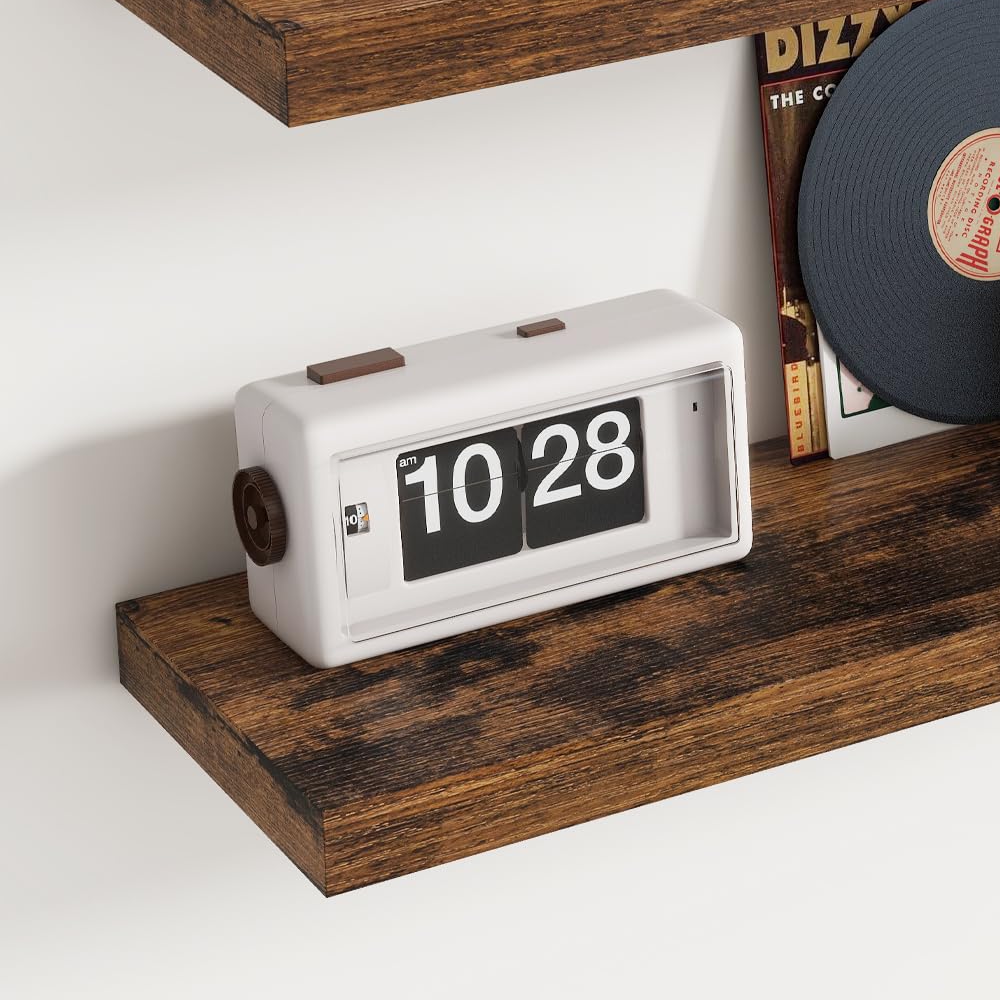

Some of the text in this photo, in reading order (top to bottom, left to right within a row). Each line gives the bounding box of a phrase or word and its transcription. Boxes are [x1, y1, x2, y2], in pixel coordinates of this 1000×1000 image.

[769, 89, 805, 110] THE
[961, 160, 996, 239] RECORDING DISC
[954, 216, 994, 273] GRAPH
[790, 363, 805, 453] BLUEBIRD
[399, 455, 417, 468] am
[404, 410, 637, 536] 10 28
